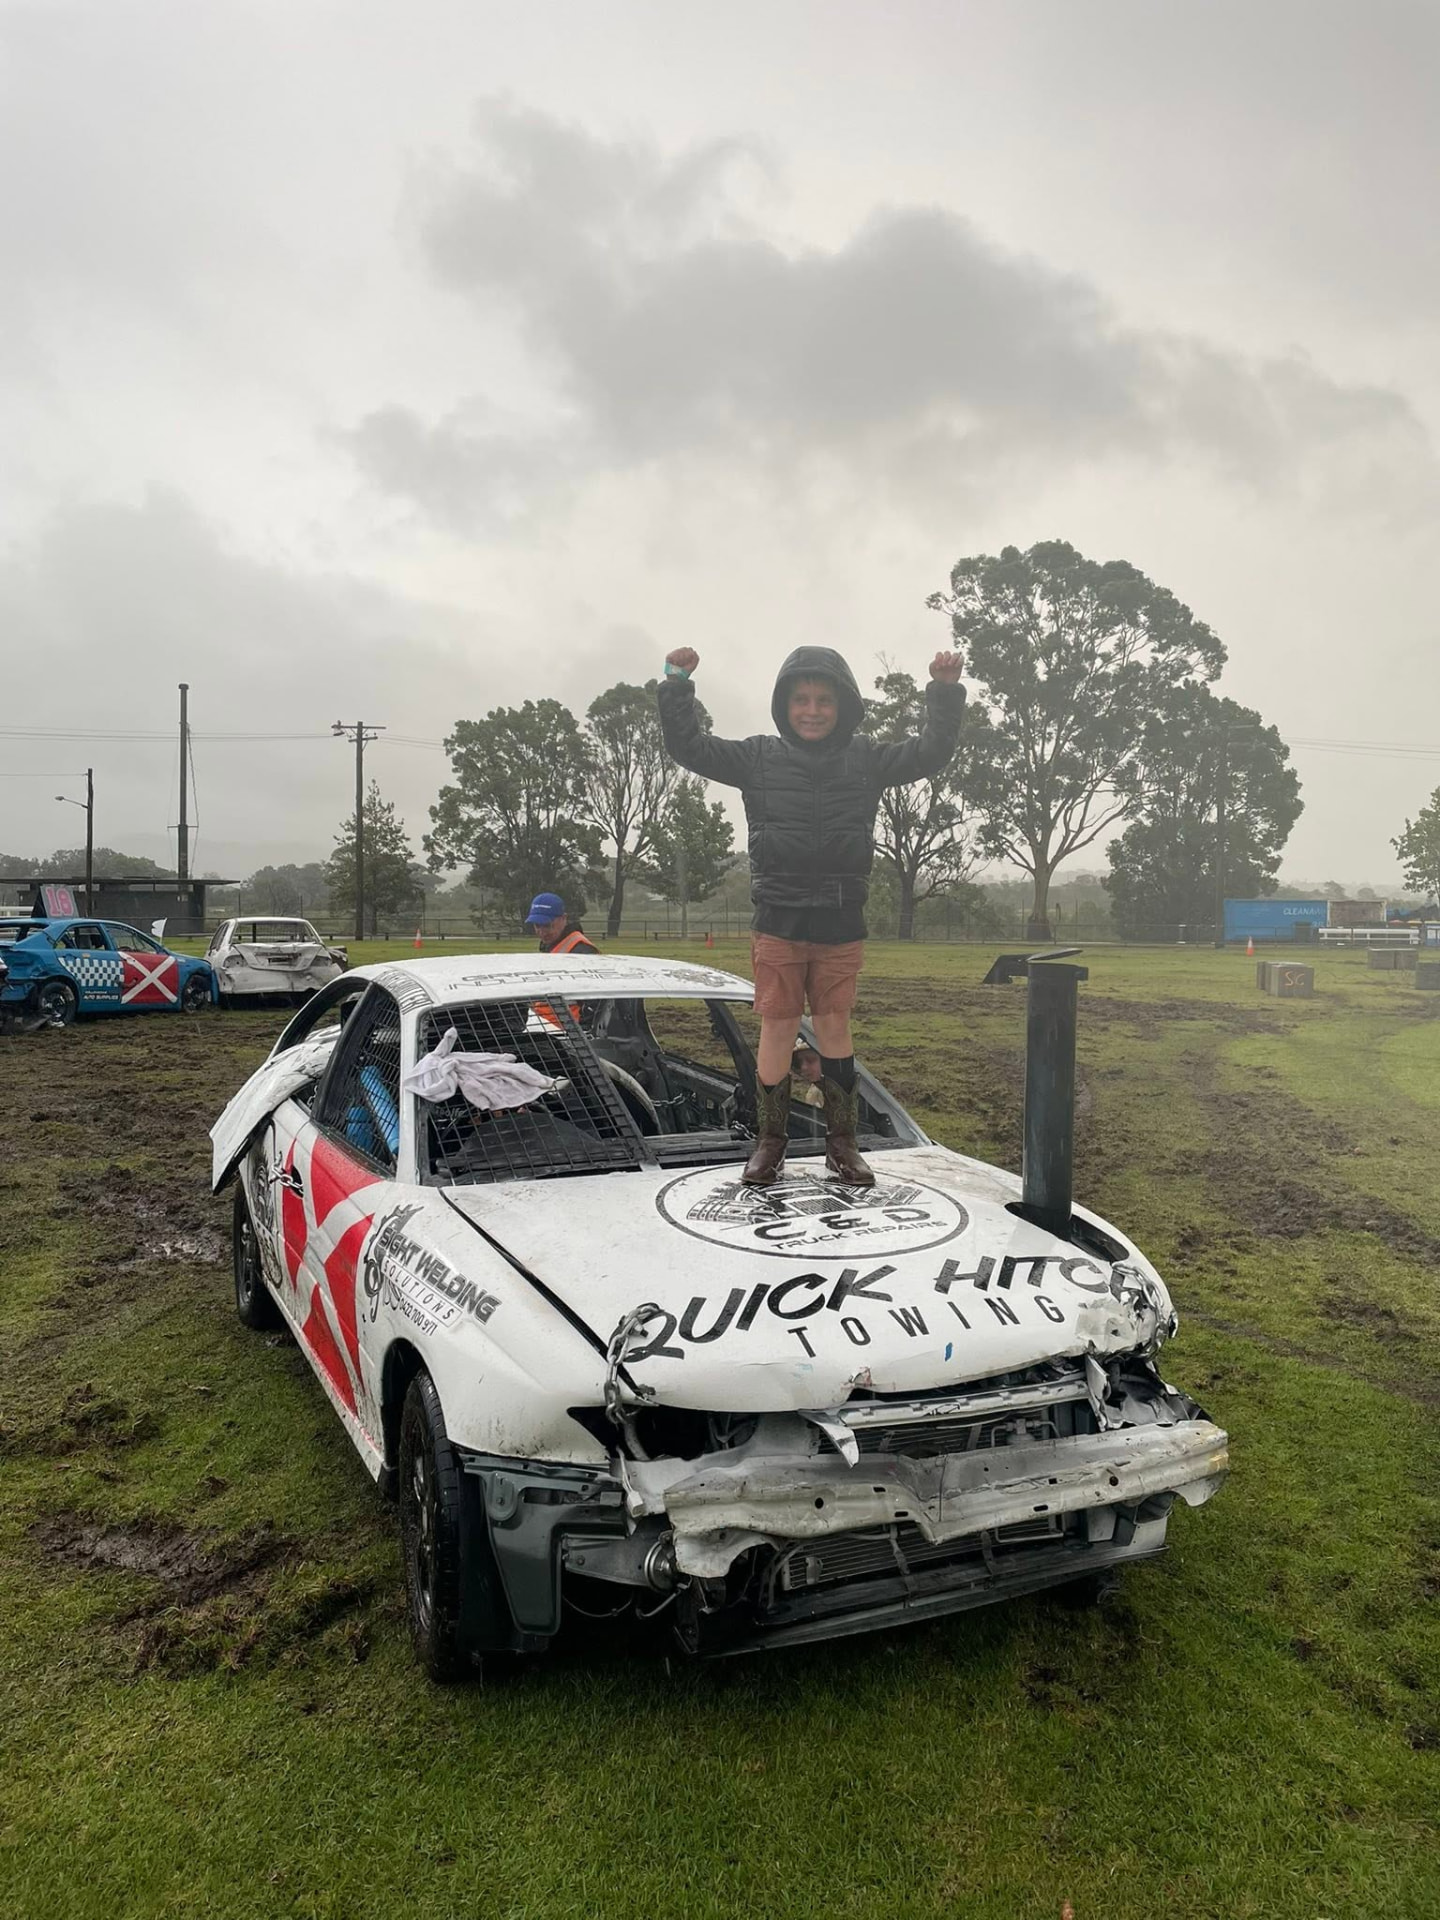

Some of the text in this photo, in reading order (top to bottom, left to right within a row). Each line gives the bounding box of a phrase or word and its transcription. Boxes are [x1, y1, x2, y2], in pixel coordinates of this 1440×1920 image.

[448, 974, 646, 991] INDUSTRIES
[461, 967, 617, 982] GRAPHIC
[753, 1207, 931, 1241] C & D
[771, 1220, 948, 1251] TRUCK REPAIRS
[383, 1260, 455, 1320] SOLUTIONS
[416, 1249, 503, 1325] WELDING
[619, 1264, 898, 1363] QUICK
[787, 1294, 1066, 1359] TOWING
